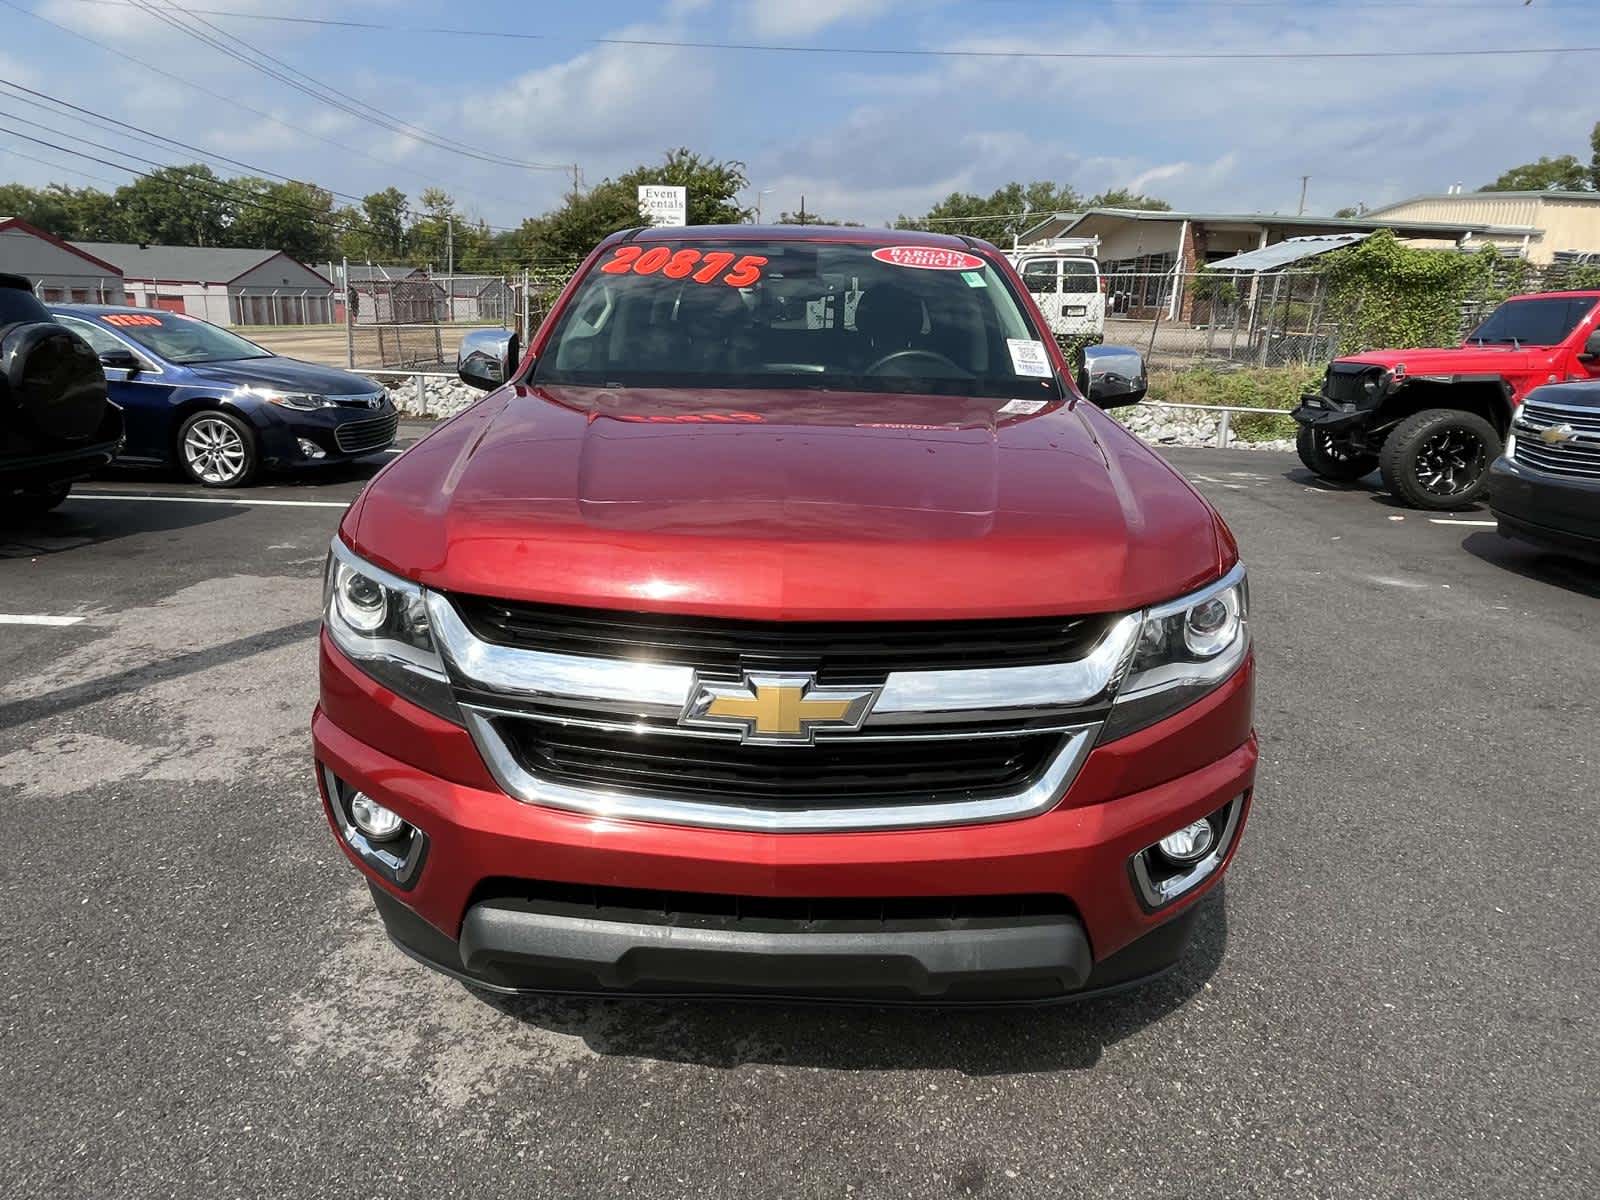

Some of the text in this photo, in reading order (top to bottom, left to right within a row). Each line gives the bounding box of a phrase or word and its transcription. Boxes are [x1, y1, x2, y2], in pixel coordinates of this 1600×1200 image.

[646, 188, 678, 199] Event
[890, 247, 965, 261] BARGAIN
[601, 246, 768, 288] 20875
[891, 255, 968, 269] VEHICLE
